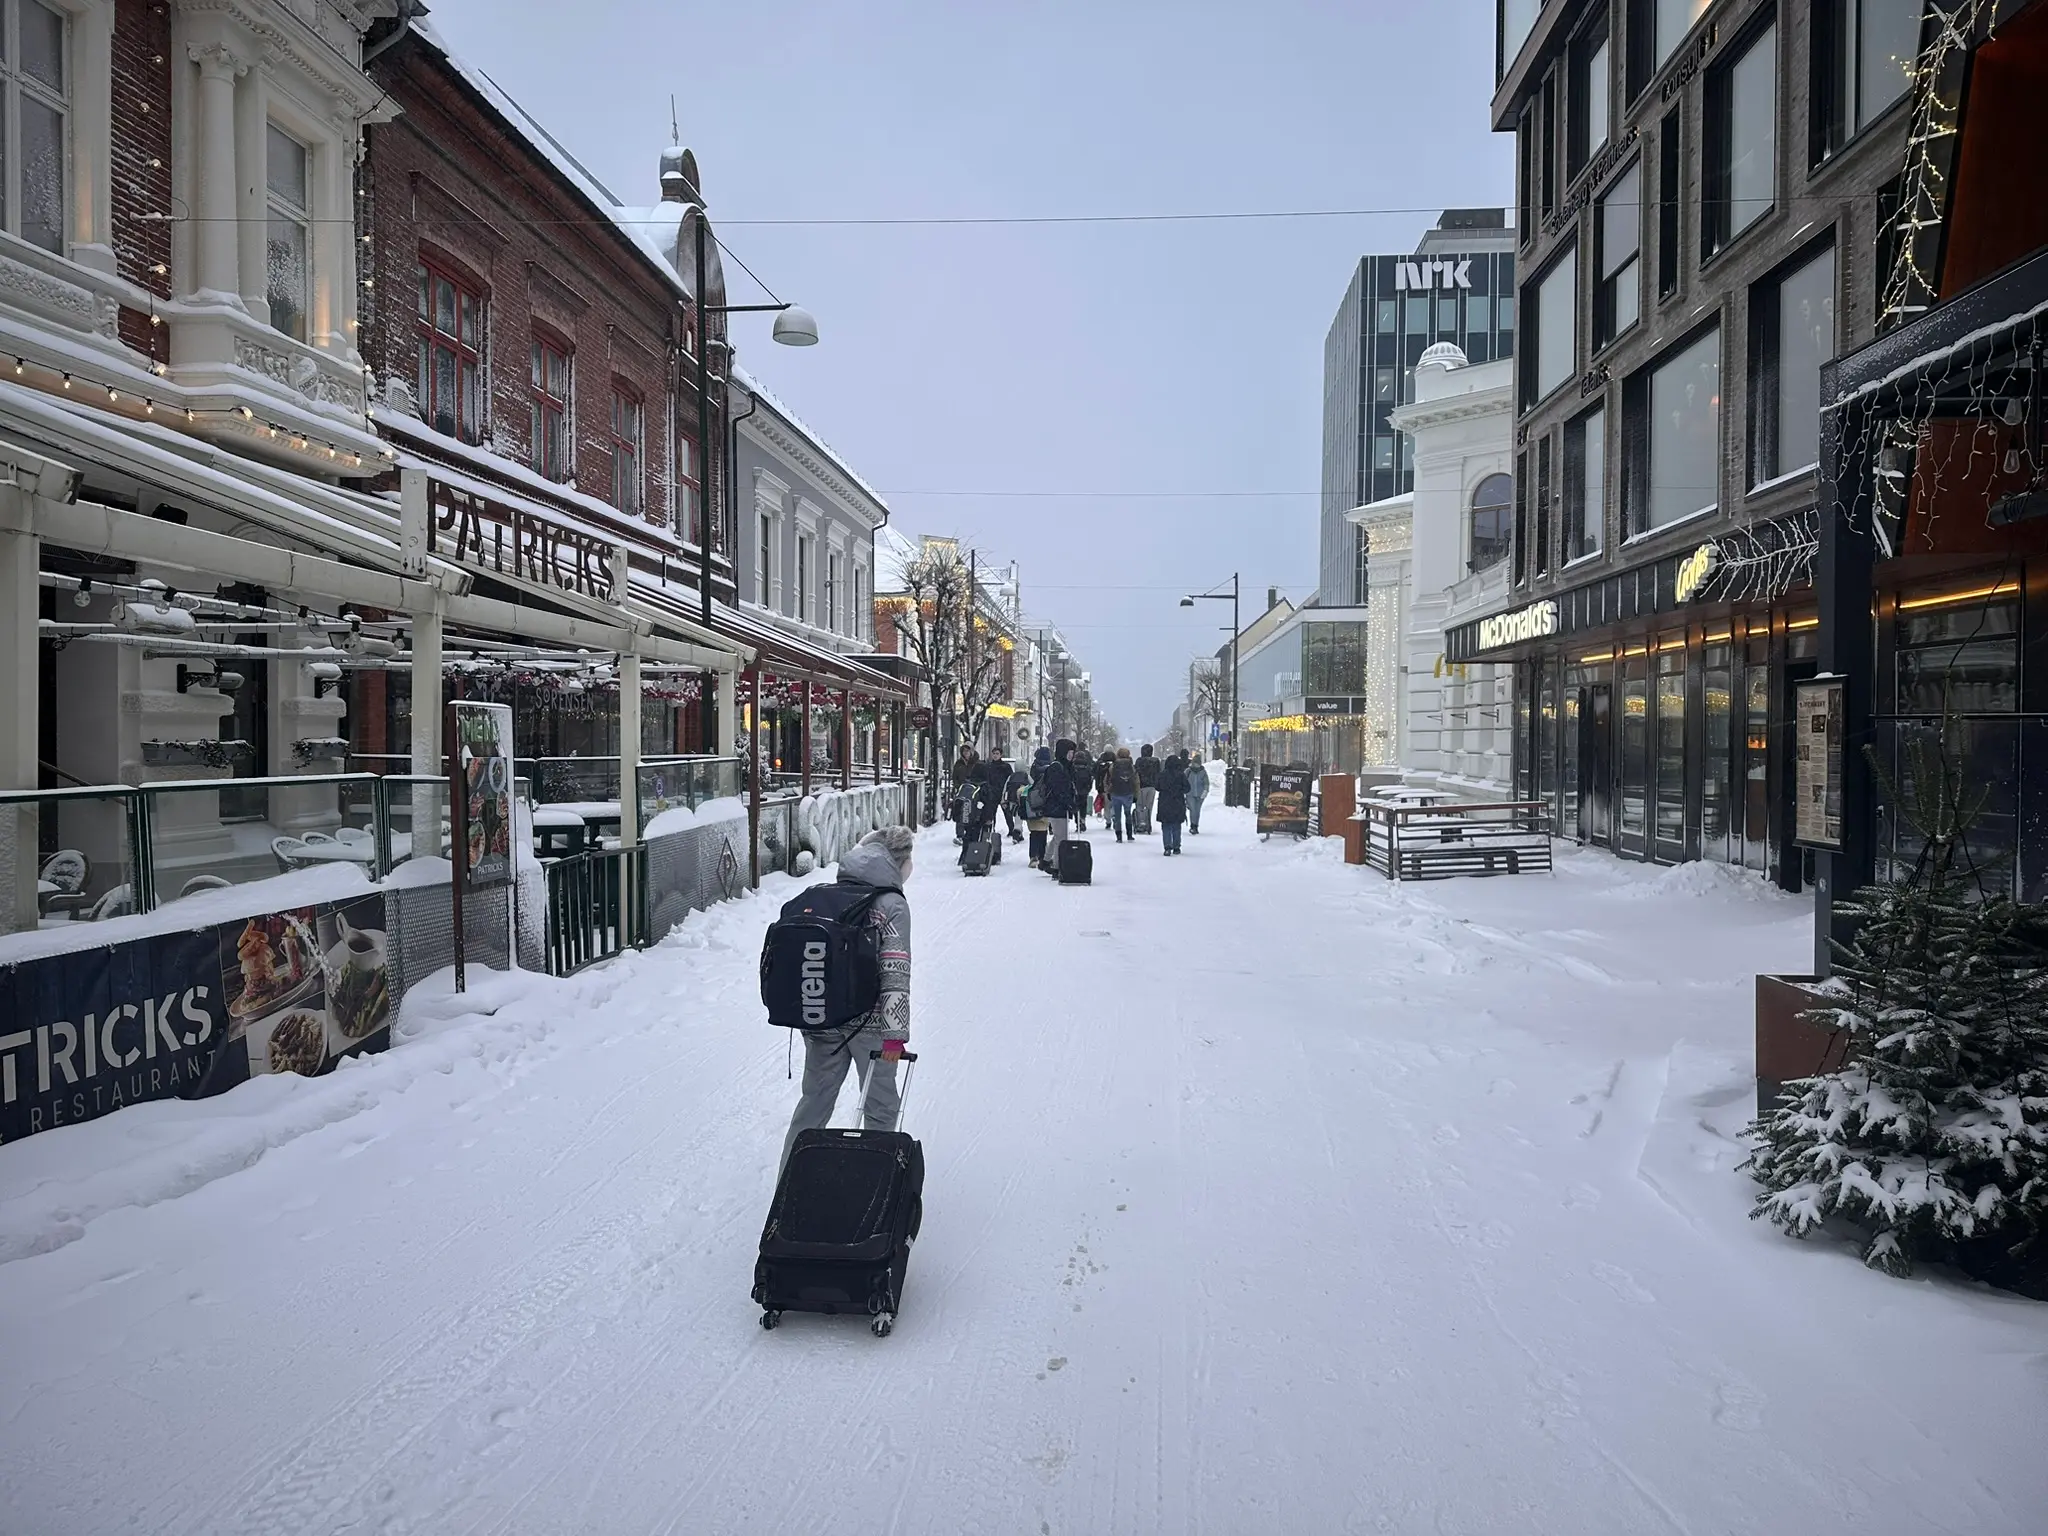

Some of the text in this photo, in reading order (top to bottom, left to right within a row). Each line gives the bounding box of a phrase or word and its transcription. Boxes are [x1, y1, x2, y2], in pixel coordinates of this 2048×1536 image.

[427, 477, 615, 604] PATRICKS
[1479, 599, 1558, 650] McDonald's
[459, 714, 500, 742] MEN
[1316, 701, 1338, 710] value
[1283, 775, 1303, 784] HONEY
[477, 862, 504, 876] PATRICKS
[801, 941, 827, 1025] arena
[0, 984, 213, 1104] TRICKS
[30, 1050, 217, 1134] RESTAURANT
